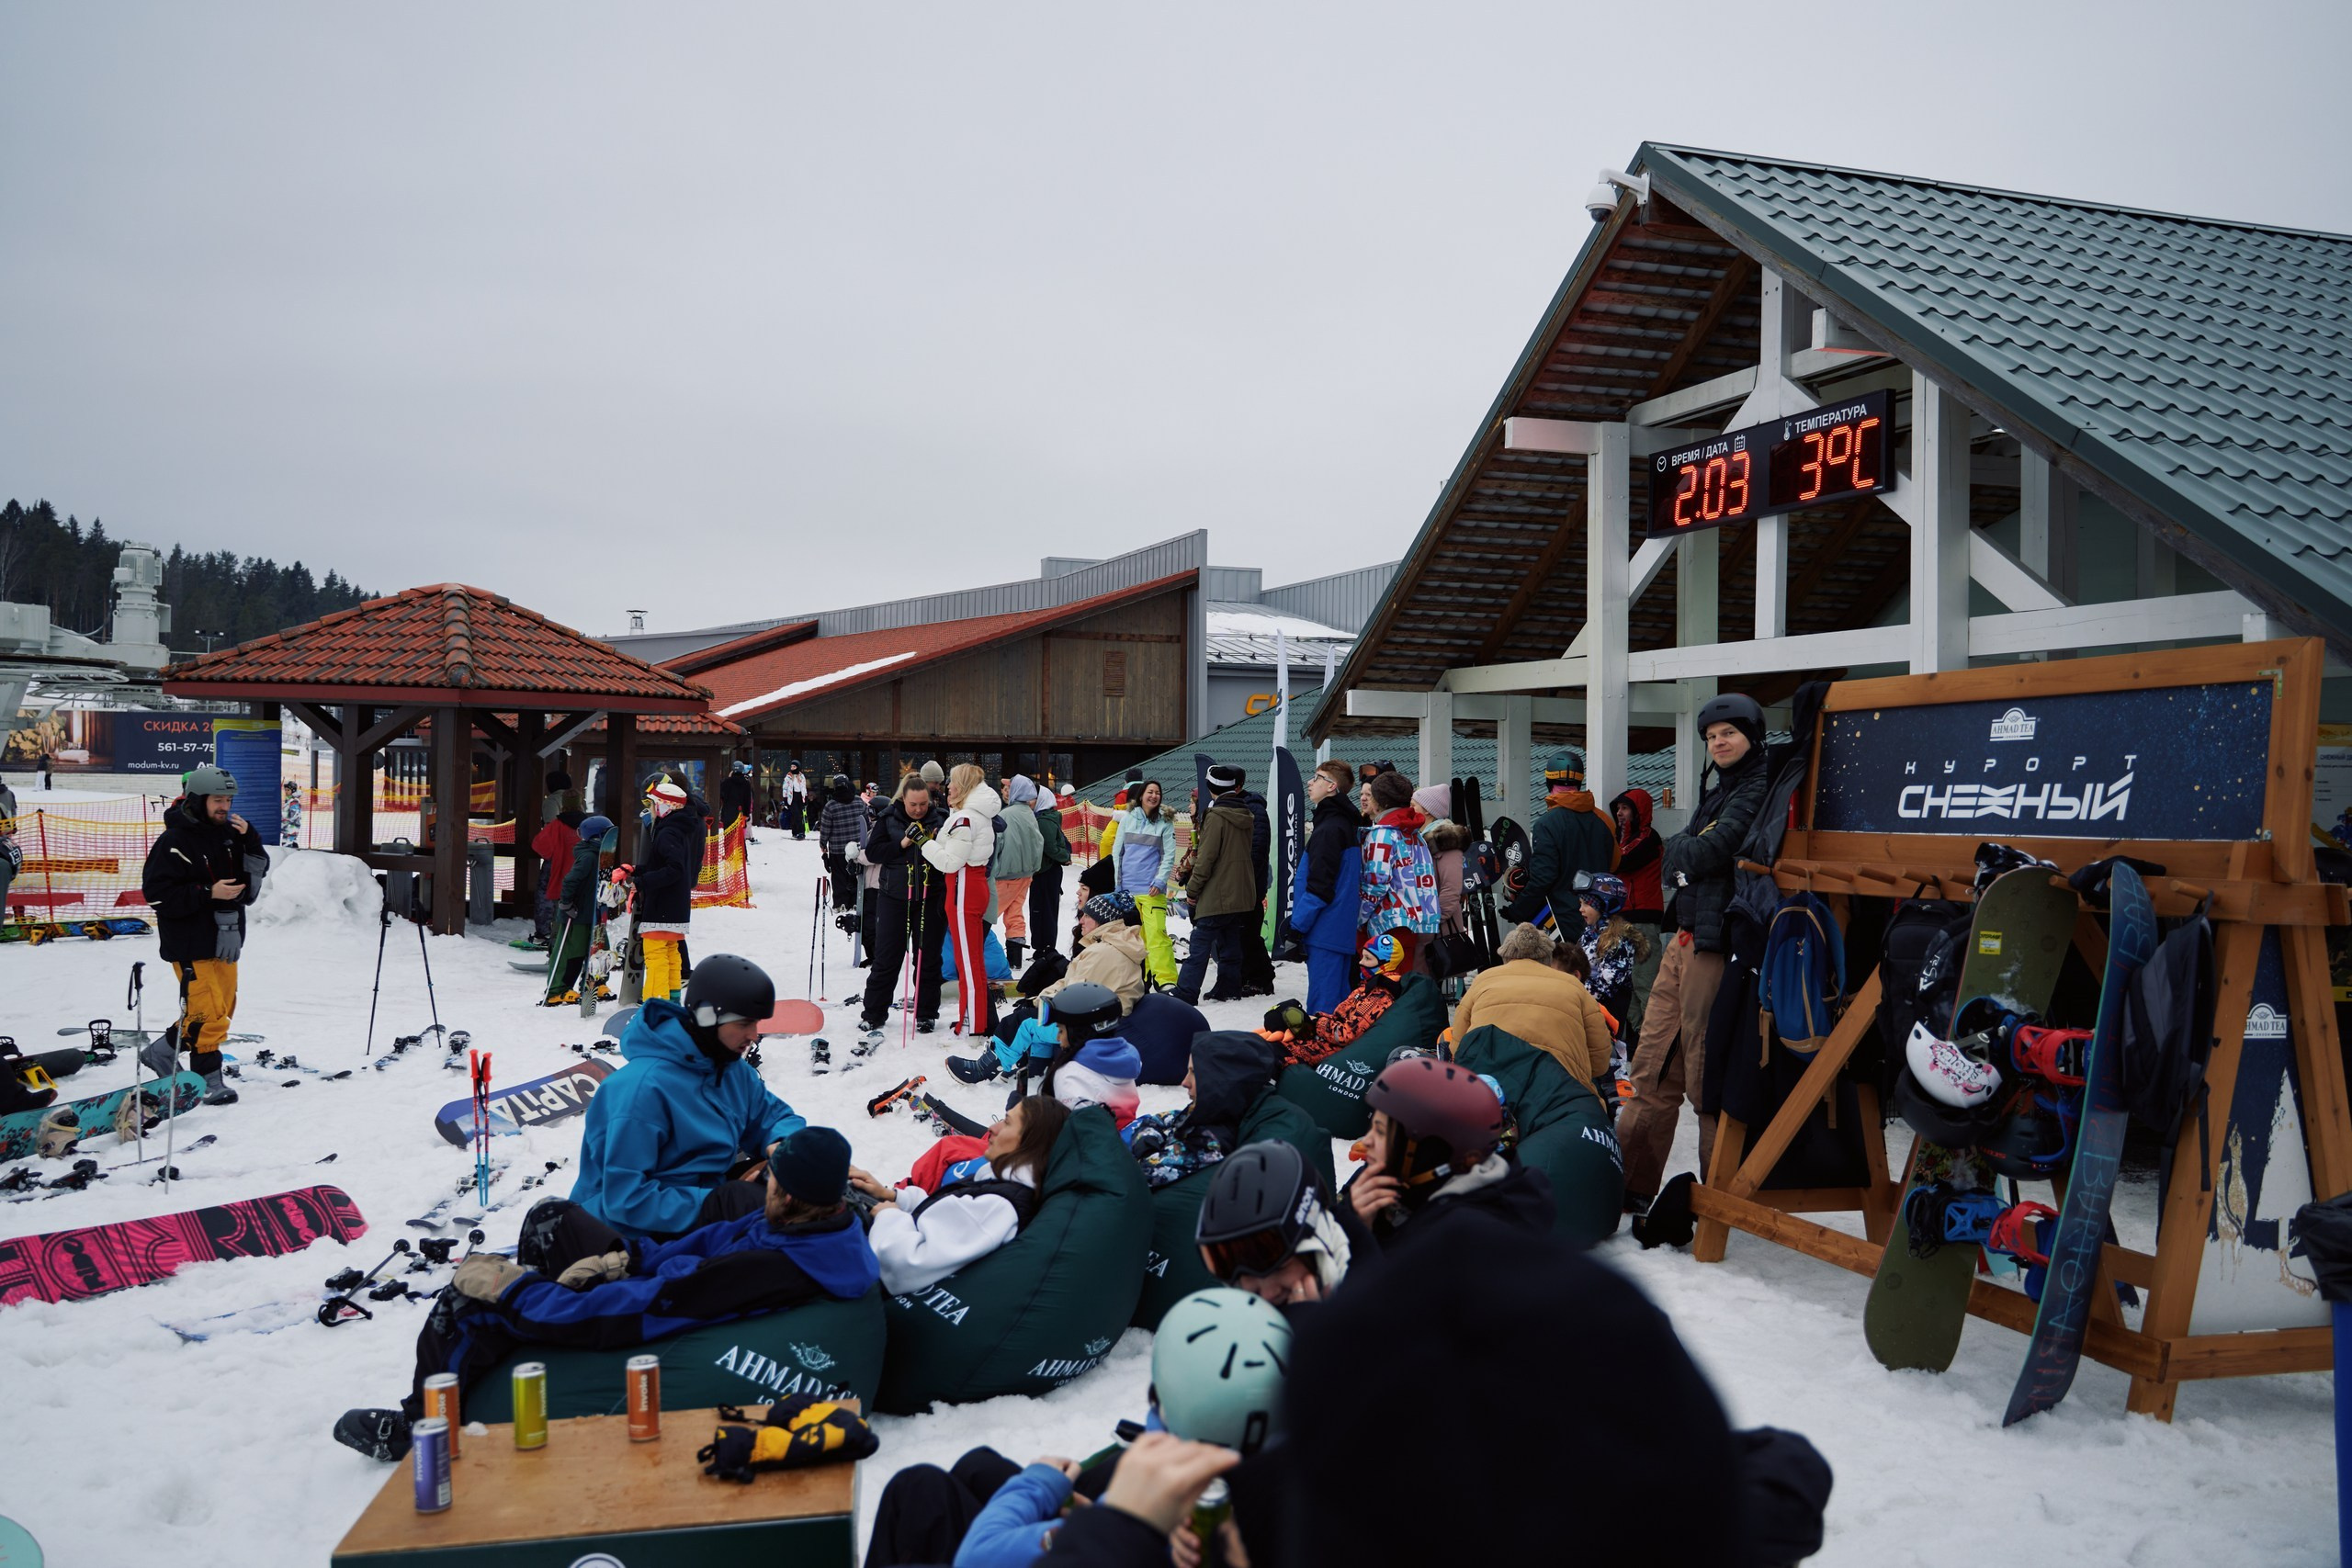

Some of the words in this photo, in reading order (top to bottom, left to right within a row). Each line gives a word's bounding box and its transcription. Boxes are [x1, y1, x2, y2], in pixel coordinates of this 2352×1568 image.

[1794, 403, 1867, 434] ТЕМПЕРАТУРА
[1671, 451, 1700, 467] ВРЕМЯ
[1705, 441, 1728, 459] ДАТА
[1674, 451, 1750, 526] 2.03
[143, 720, 198, 734] СКИДКА
[1992, 724, 2018, 734] AHMAD
[2019, 723, 2033, 733] TEA
[127, 761, 180, 770] modum-kv.ru
[1897, 772, 2134, 820] СНЕЖНЫЙ
[2245, 1021, 2269, 1031] HMAD
[2270, 1021, 2286, 1031] TEA
[1329, 1084, 1360, 1100] LONDON
[2048, 1150, 2117, 1333] BURTON
[923, 1288, 970, 1325] TEA
[714, 1345, 822, 1397] AHMAD
